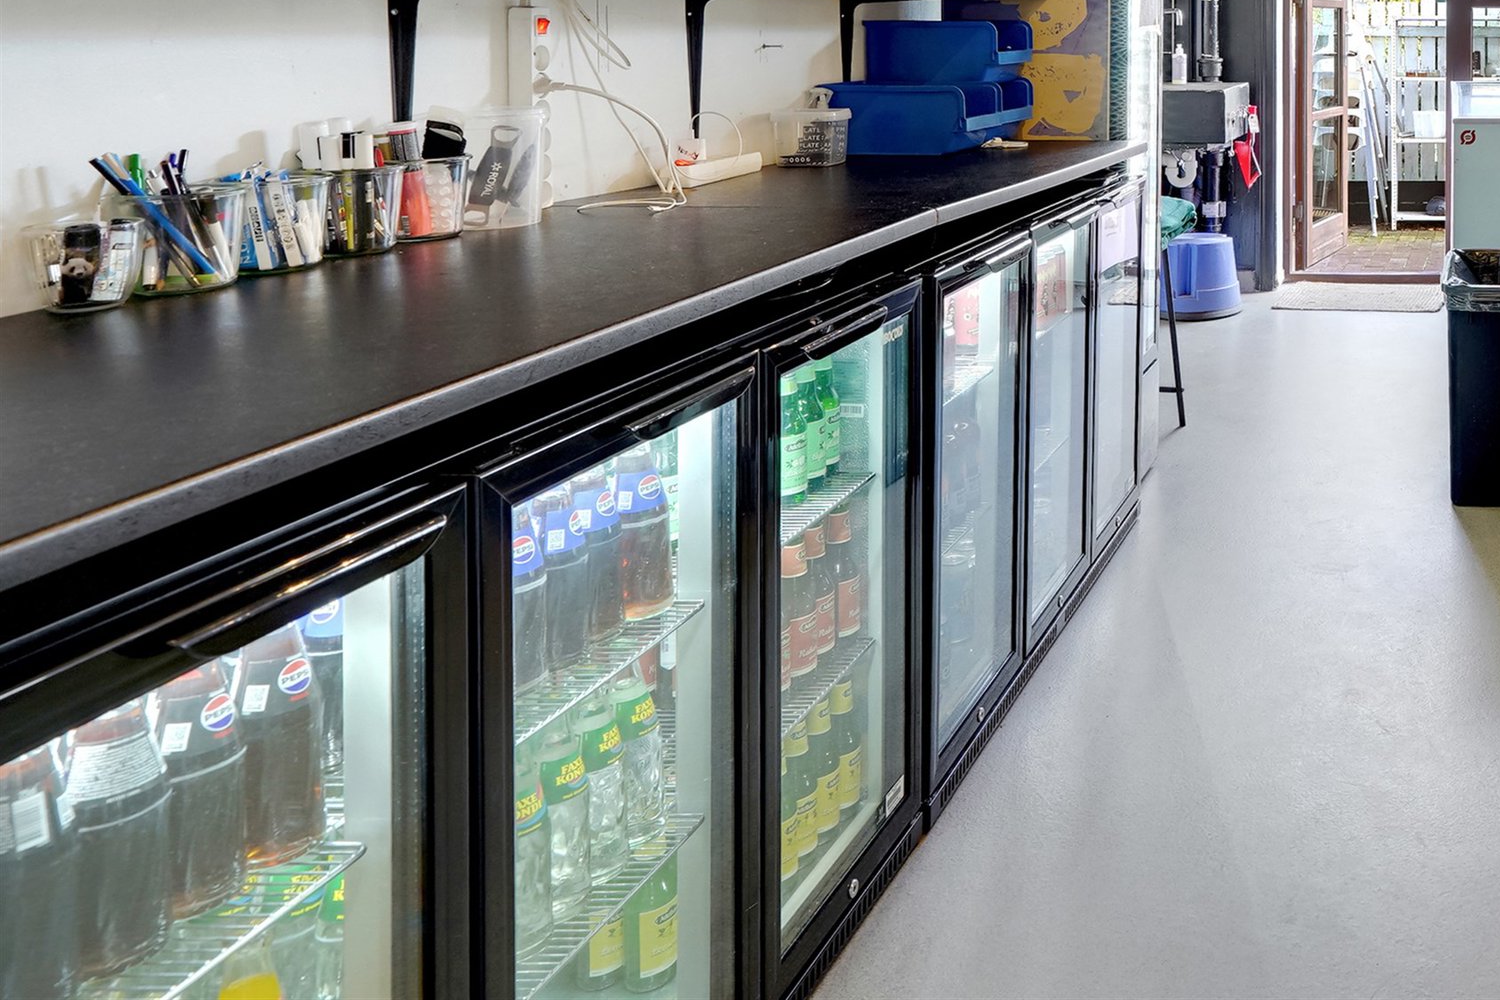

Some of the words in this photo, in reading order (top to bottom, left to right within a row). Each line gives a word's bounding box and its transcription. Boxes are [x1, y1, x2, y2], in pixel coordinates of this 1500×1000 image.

[480, 171, 499, 197] ROYAL
[281, 669, 309, 685] PEPS
[205, 705, 233, 722] PEPS
[515, 792, 538, 809] AXE
[515, 800, 543, 819] ONDI
